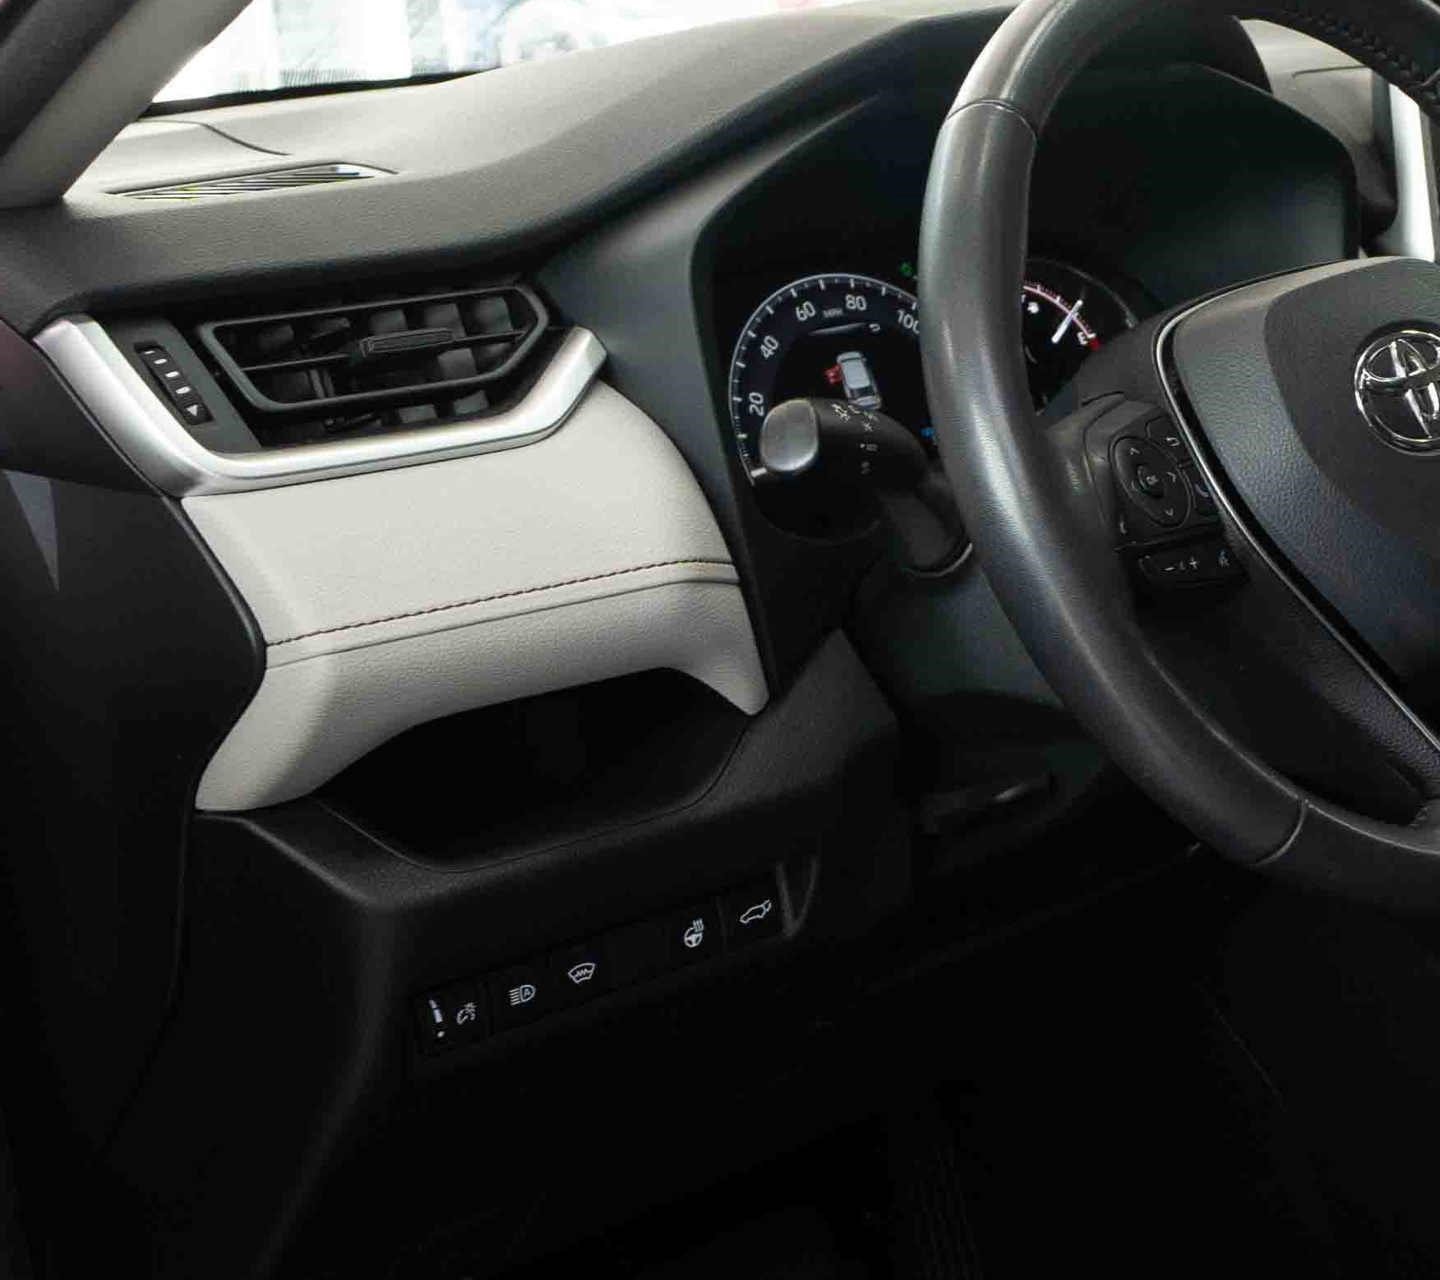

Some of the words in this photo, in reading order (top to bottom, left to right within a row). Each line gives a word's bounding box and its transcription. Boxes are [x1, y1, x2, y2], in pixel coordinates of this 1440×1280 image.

[795, 301, 816, 322] 60
[845, 294, 867, 311] 80
[760, 335, 780, 360] 40
[749, 392, 765, 418] 20
